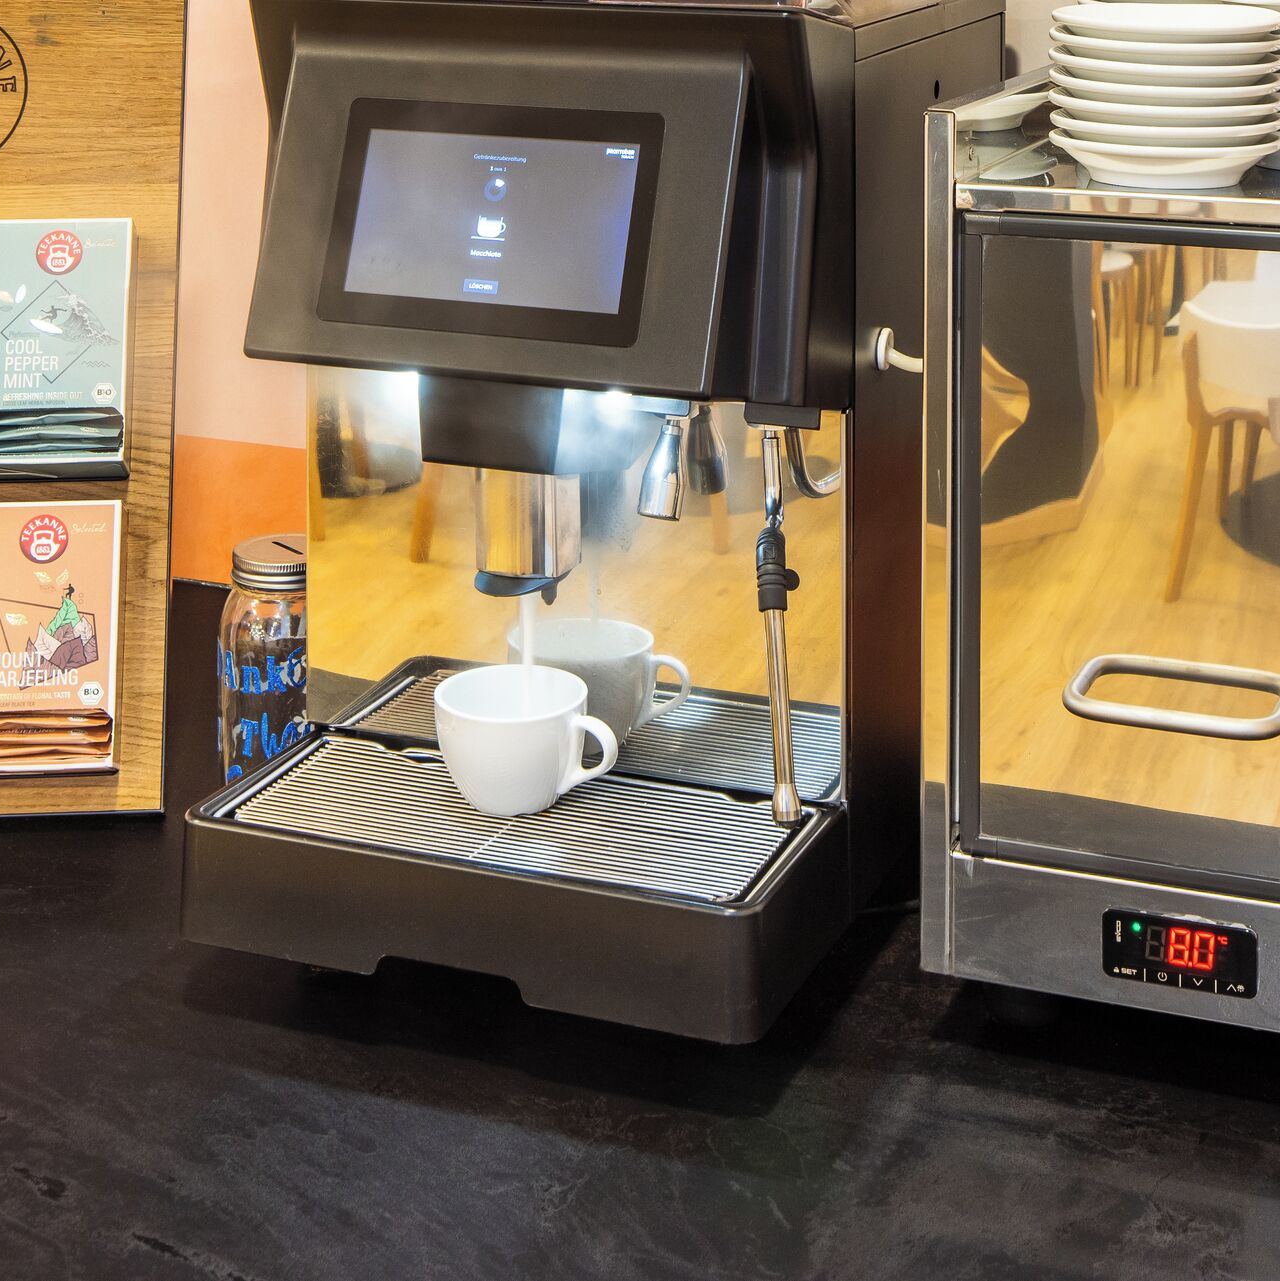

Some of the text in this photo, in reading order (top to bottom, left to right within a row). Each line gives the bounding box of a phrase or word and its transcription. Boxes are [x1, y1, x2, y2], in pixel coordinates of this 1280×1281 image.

[37, 232, 81, 255] TEEKANNE
[5, 339, 43, 355] COOL
[4, 356, 59, 372] PEPPER
[3, 373, 43, 389] MINT
[20, 517, 67, 543] TEEKANNE
[54, 691, 71, 699] TASTE
[1121, 967, 1138, 976] SET
